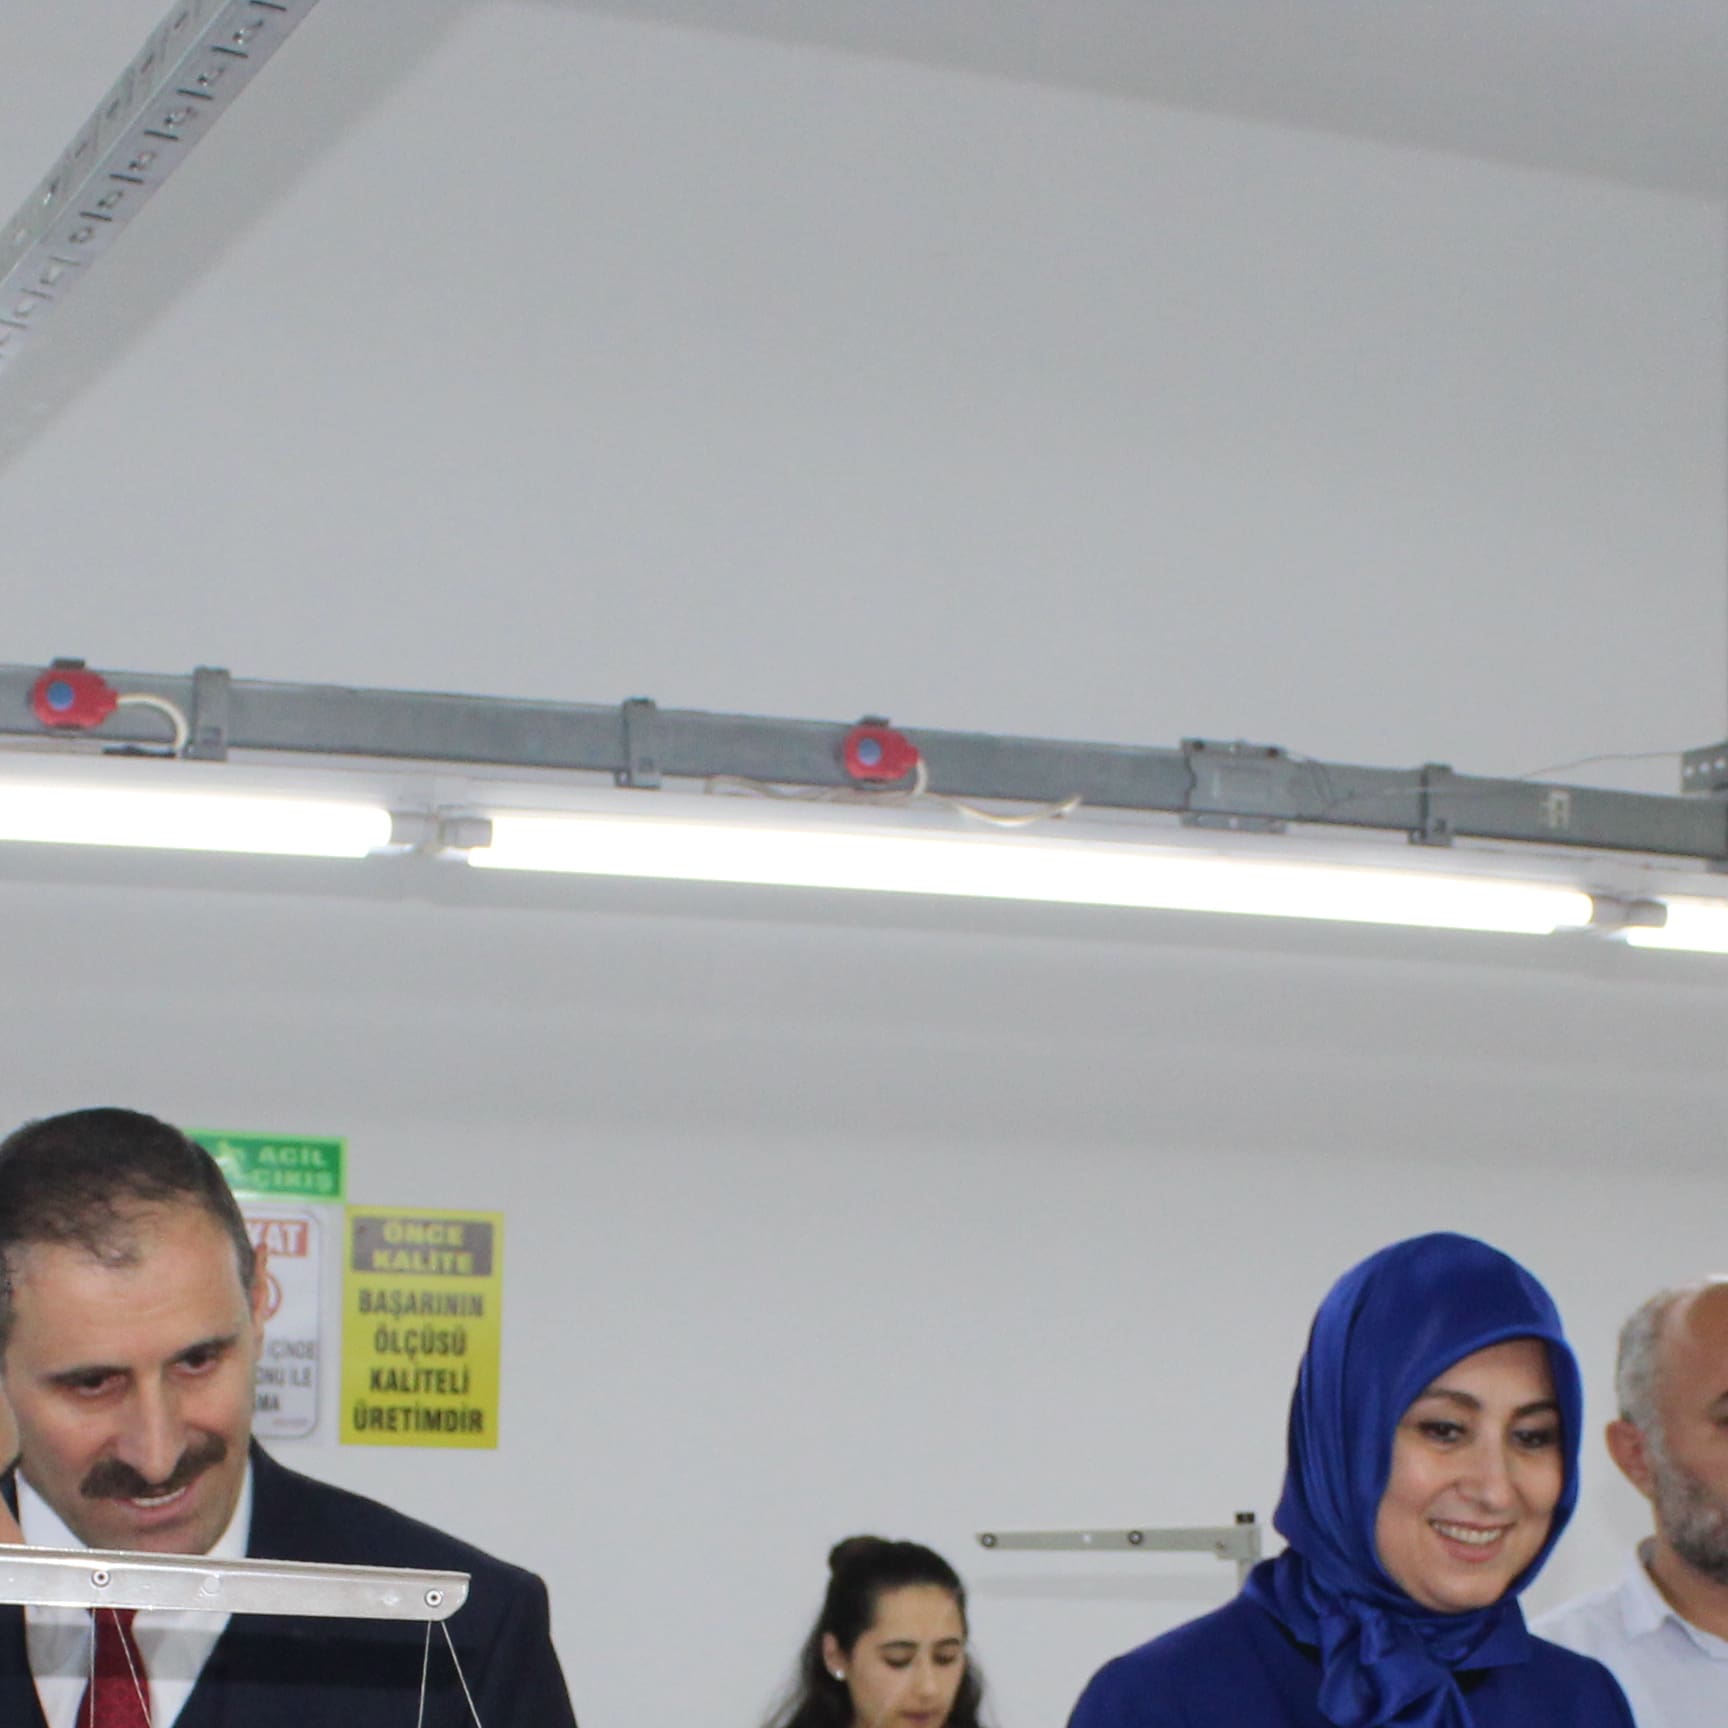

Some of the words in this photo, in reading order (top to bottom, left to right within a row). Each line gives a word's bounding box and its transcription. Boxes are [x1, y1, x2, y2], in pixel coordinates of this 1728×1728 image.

[358, 1288, 484, 1320] BAŞARININ
[373, 1325, 467, 1361] ÖLÇÜSÜ
[369, 1365, 471, 1395] KALİTELİ
[353, 1401, 484, 1434] ÜRETİMDİR
